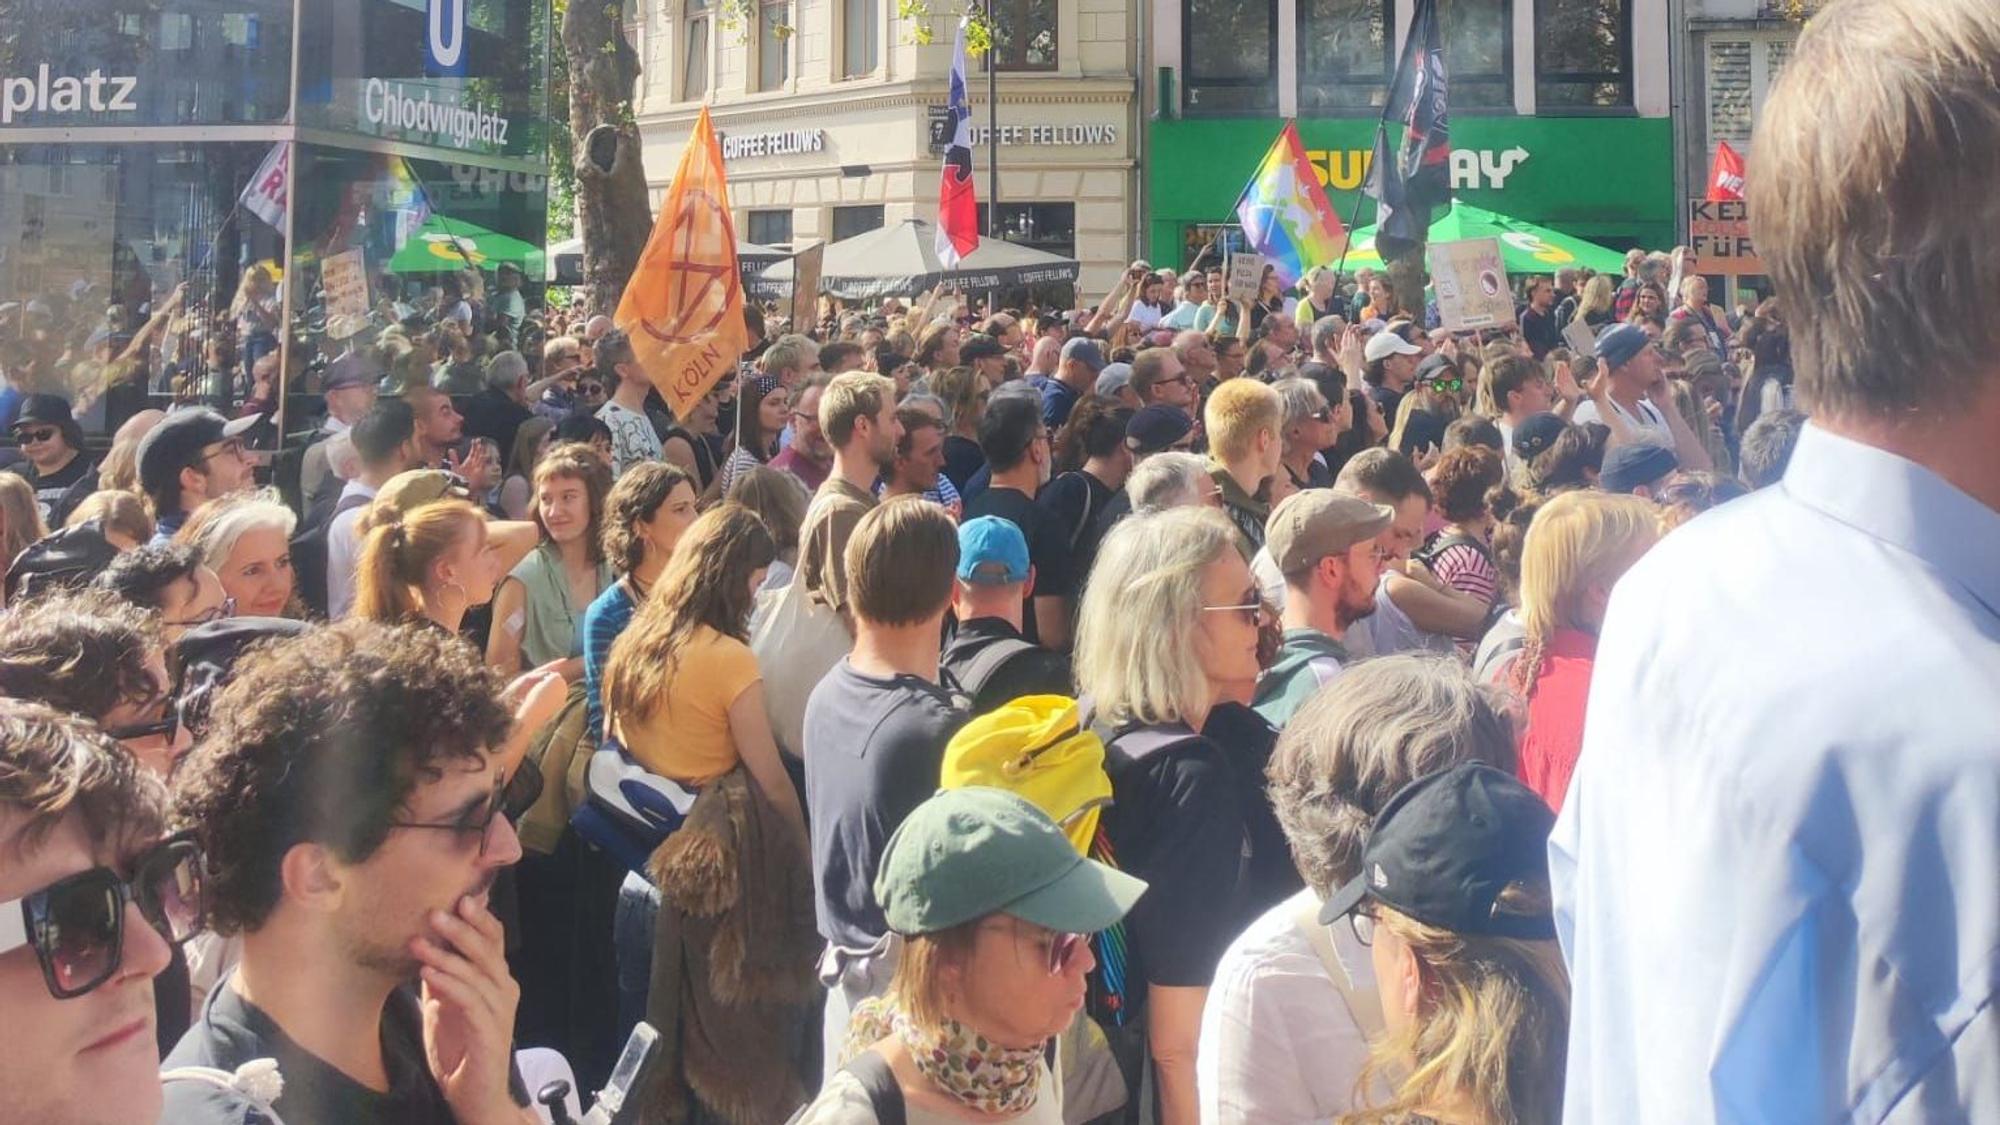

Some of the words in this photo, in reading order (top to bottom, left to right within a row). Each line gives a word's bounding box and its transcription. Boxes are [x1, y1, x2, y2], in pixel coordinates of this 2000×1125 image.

[2, 62, 137, 124] platz
[365, 77, 508, 148] Chlodwigplatz
[723, 132, 766, 160] COFFEE
[767, 127, 823, 155] FELLOWS
[968, 126, 1024, 146] OFEE
[1030, 123, 1116, 146] FELLOWS
[1304, 146, 1531, 190] SUAY
[1692, 201, 1748, 221] KEI
[1692, 235, 1758, 258] FÜR
[673, 342, 721, 403] KÖLN
